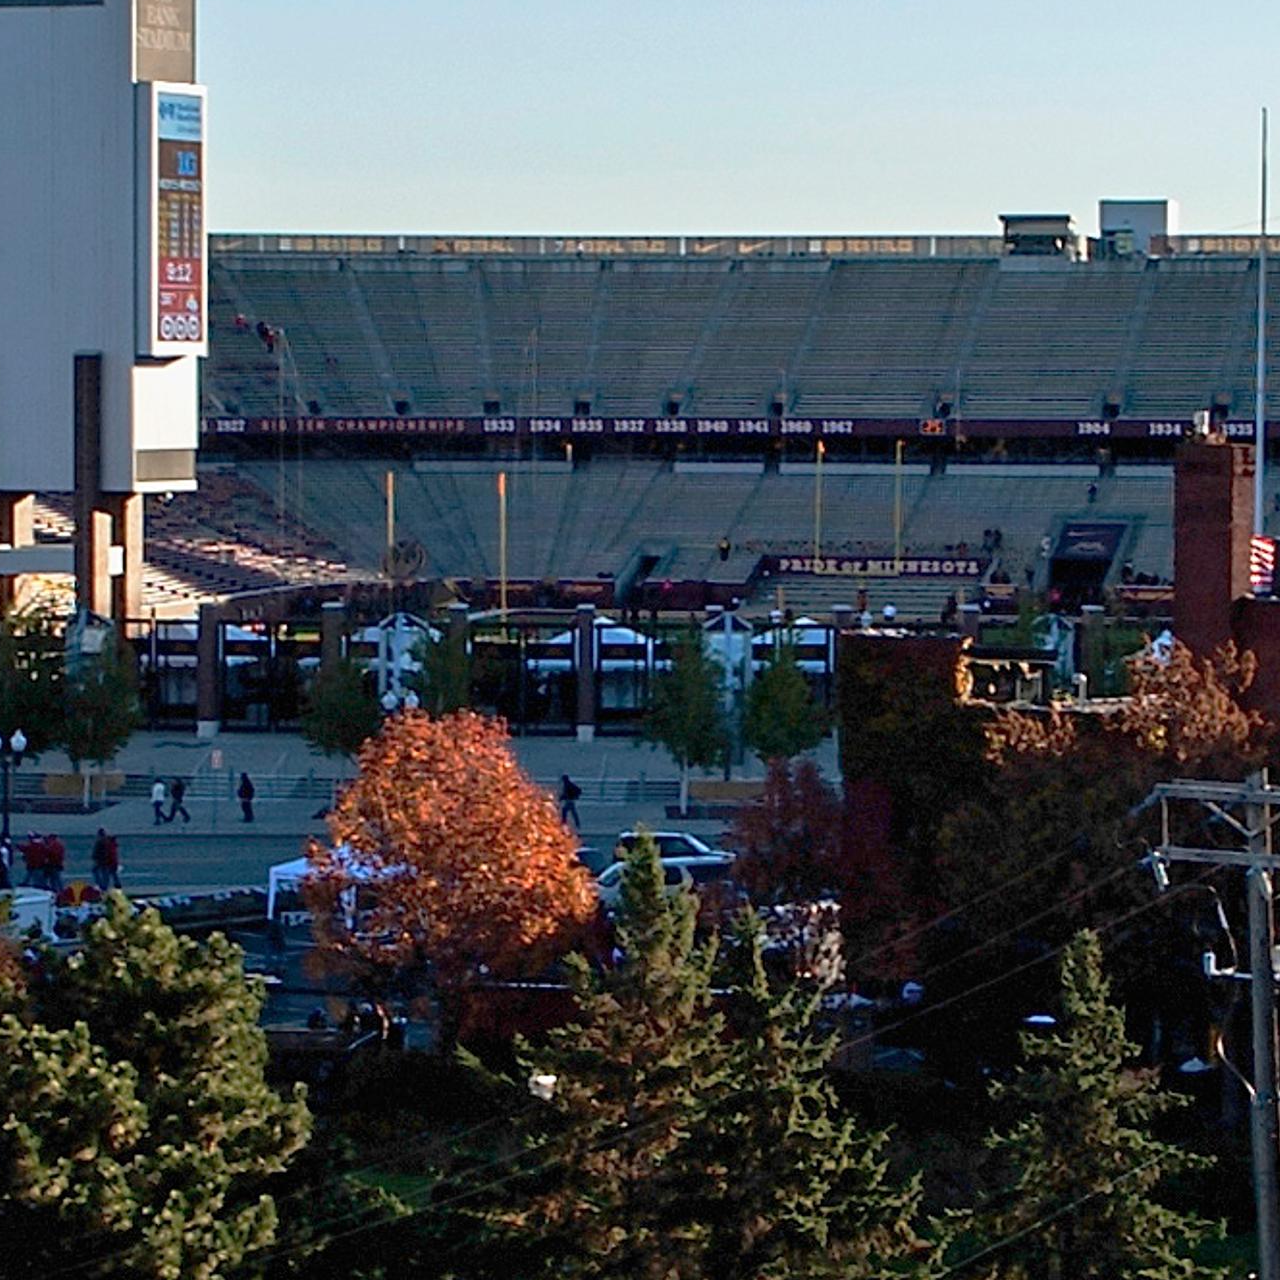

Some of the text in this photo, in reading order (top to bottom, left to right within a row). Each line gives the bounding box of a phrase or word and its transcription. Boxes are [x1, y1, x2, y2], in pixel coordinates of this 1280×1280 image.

[336, 419, 466, 432] CHAMPIONSHIPS
[482, 419, 515, 433] 1933
[528, 419, 562, 433] 1934
[696, 419, 729, 433] 1940
[779, 558, 838, 572] PRIDE
[867, 558, 981, 575] MINNESOTA
